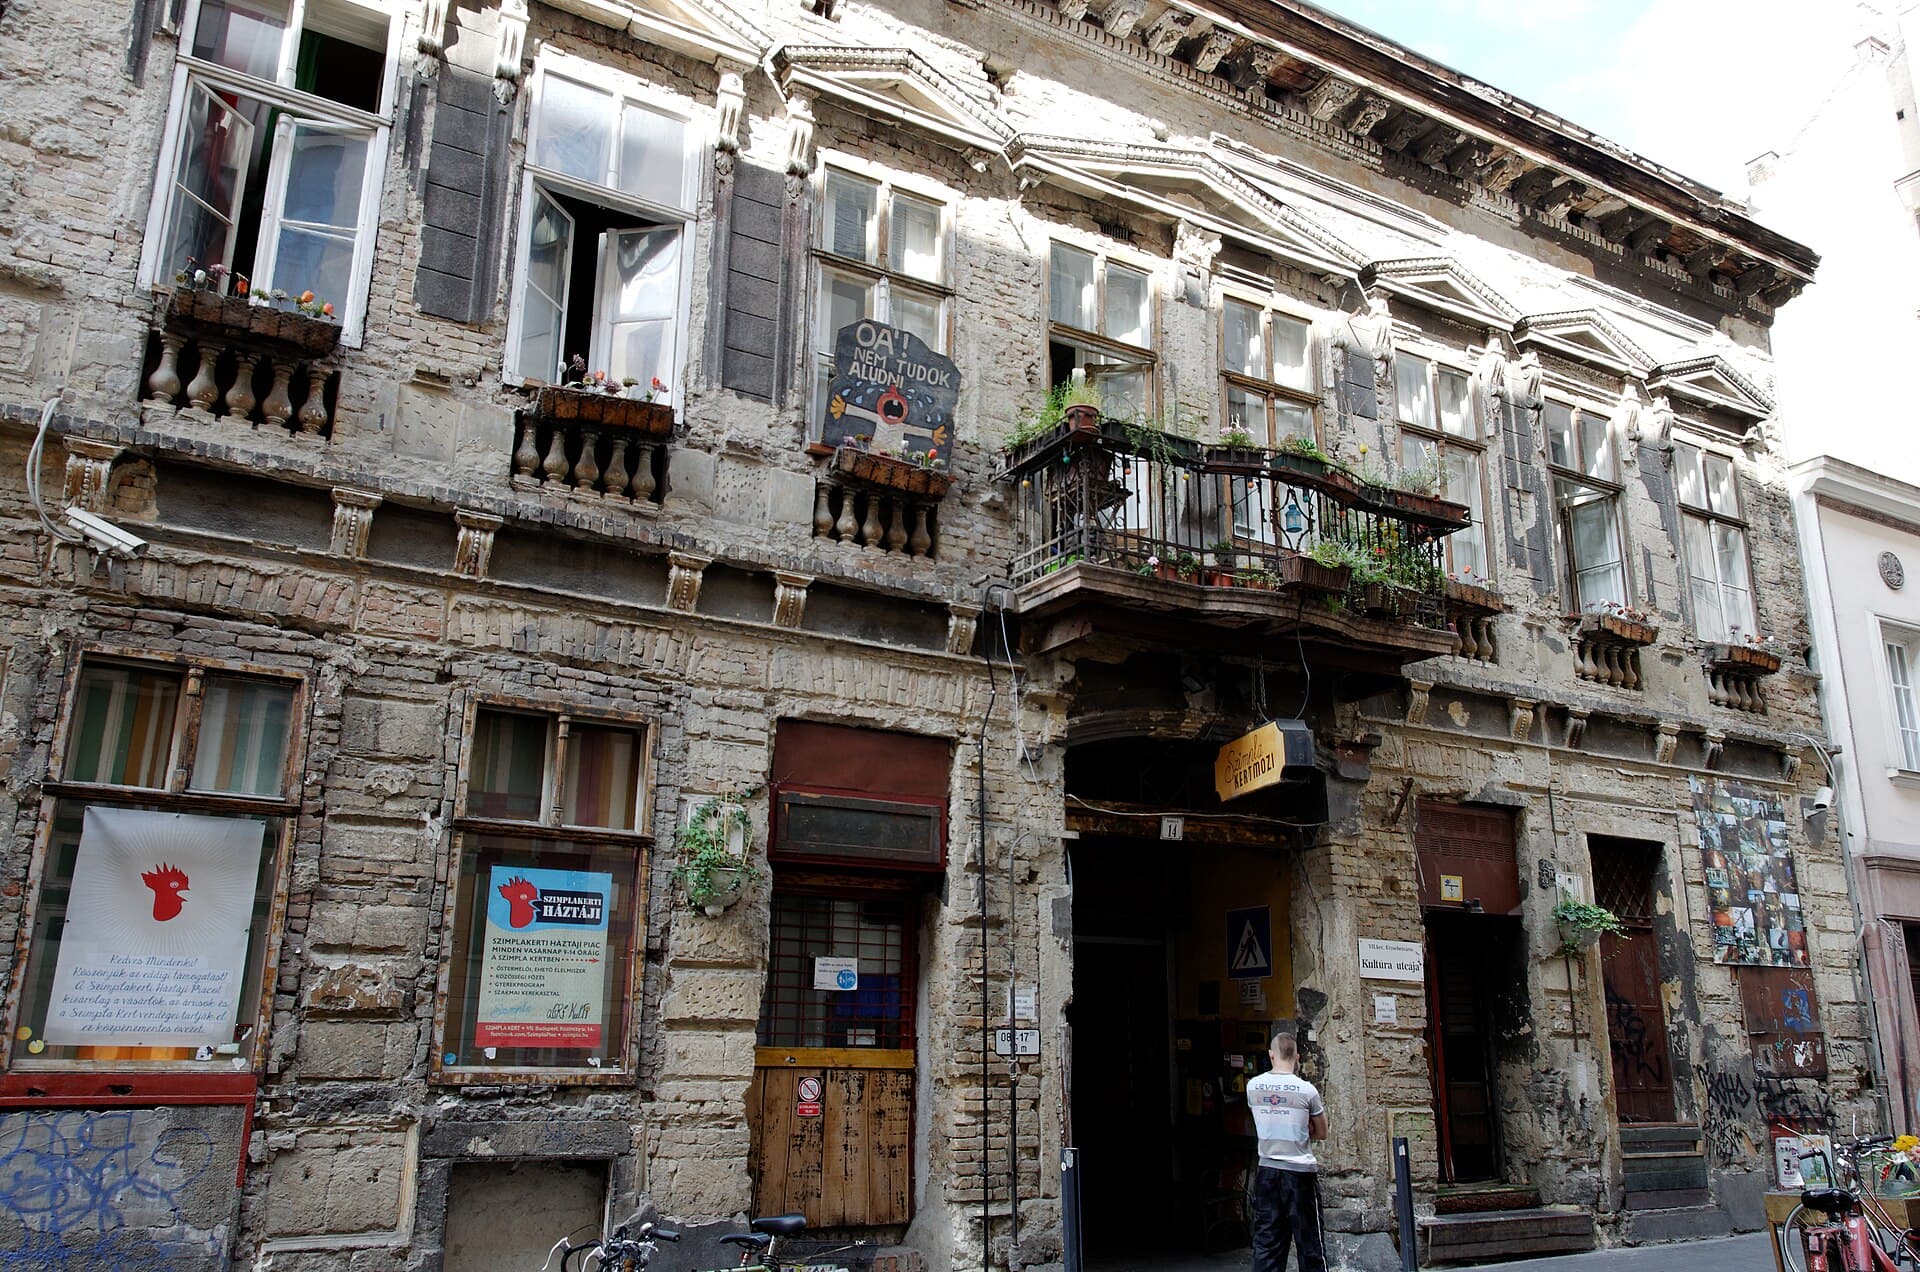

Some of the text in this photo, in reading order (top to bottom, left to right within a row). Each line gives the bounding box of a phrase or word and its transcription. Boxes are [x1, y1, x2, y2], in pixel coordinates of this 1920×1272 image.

[848, 361, 905, 389] ALUDNI
[854, 347, 951, 389] NEM TUDOK
[1234, 752, 1275, 790] KERTMOZI
[1168, 824, 1178, 838] 14
[543, 895, 603, 906] SZIMPLAKERTI
[542, 903, 601, 920] HÁZTÁJI
[492, 937, 549, 947] SZIMPLAKERTI
[583, 941, 601, 949] PIAC
[491, 946, 522, 954] MINDEN
[524, 946, 563, 956] VASÁRNAP
[110, 953, 199, 968] Kedves Mindenki!
[498, 954, 528, 962] SZIMPLA
[529, 955, 561, 963] KERTBEN
[1361, 958, 1393, 970] Kultúra
[72, 966, 126, 981] Köszönjük
[142, 969, 170, 982] eddigi
[74, 980, 86, 991] A
[87, 980, 153, 994] Szimplakerti
[69, 1007, 113, 1021] Szimpla
[115, 1008, 138, 1019] Kert
[216, 1010, 228, 1021] el
[1283, 1084, 1301, 1093] 501
